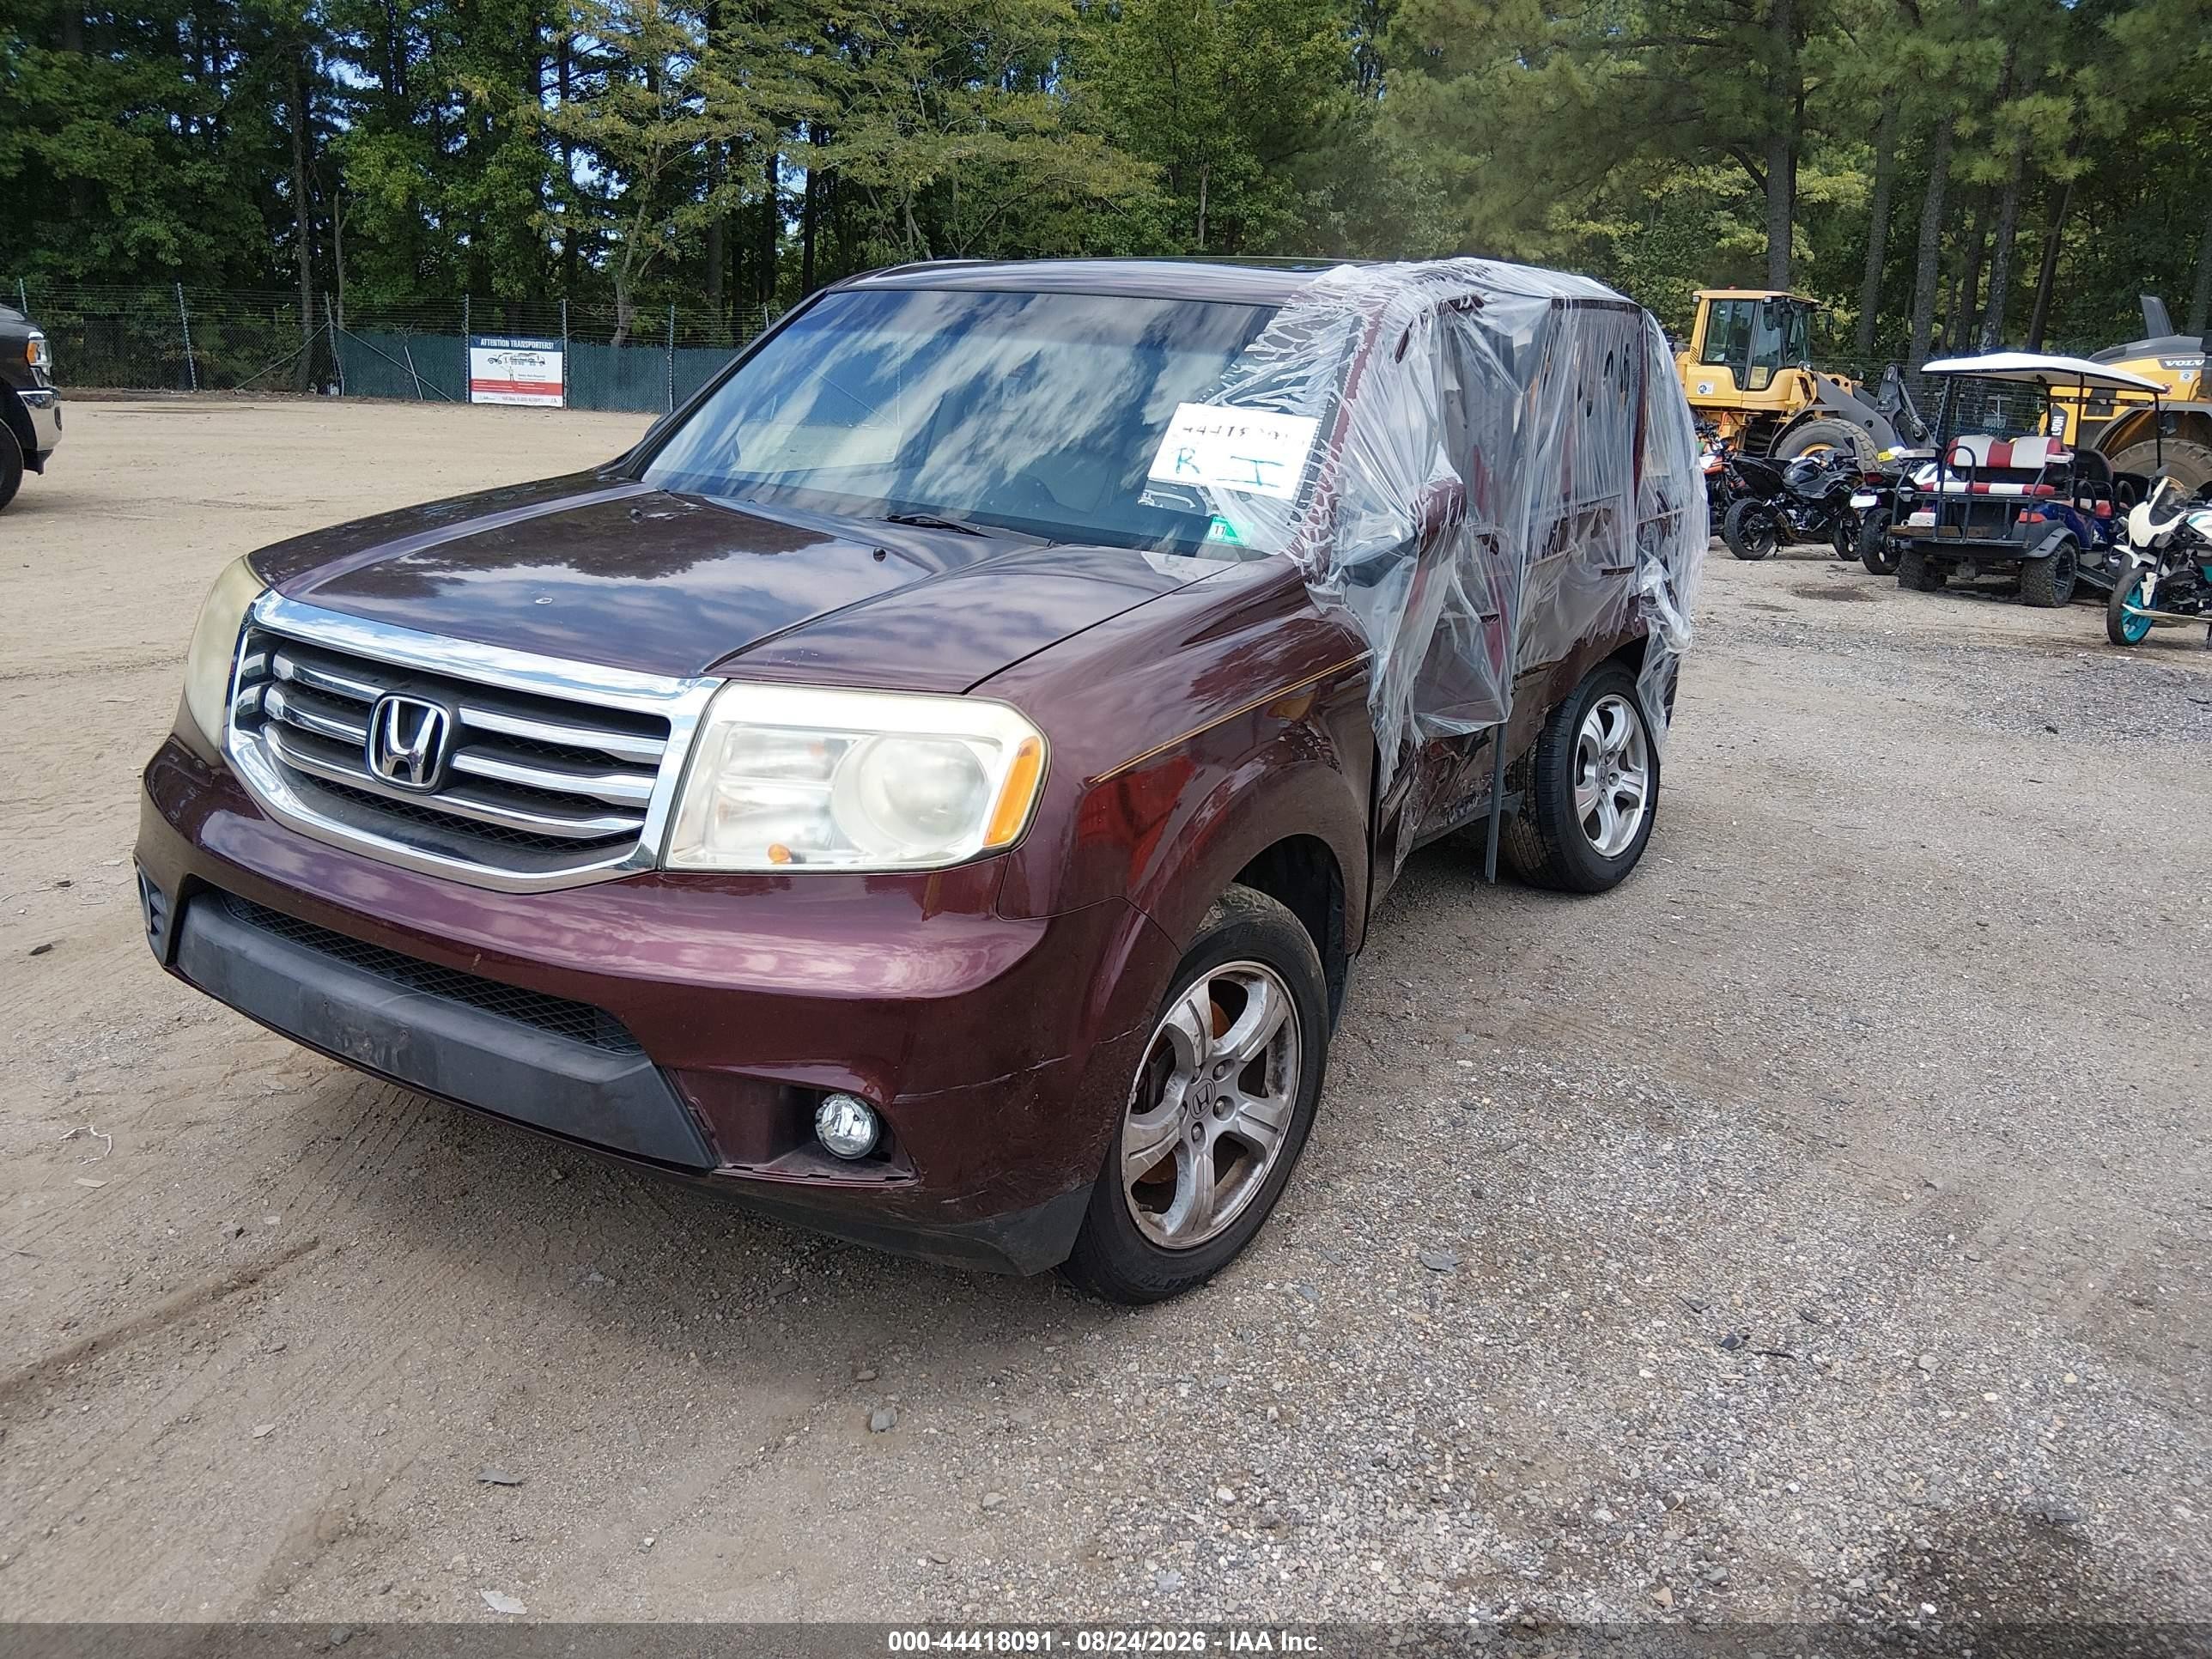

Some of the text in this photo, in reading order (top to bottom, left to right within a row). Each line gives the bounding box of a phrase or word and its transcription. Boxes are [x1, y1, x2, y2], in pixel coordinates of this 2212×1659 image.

[481, 338, 554, 349] ATTENTION TRANSPORTERS!
[2051, 416, 2064, 435] L90H
[1176, 447, 1200, 474] R
